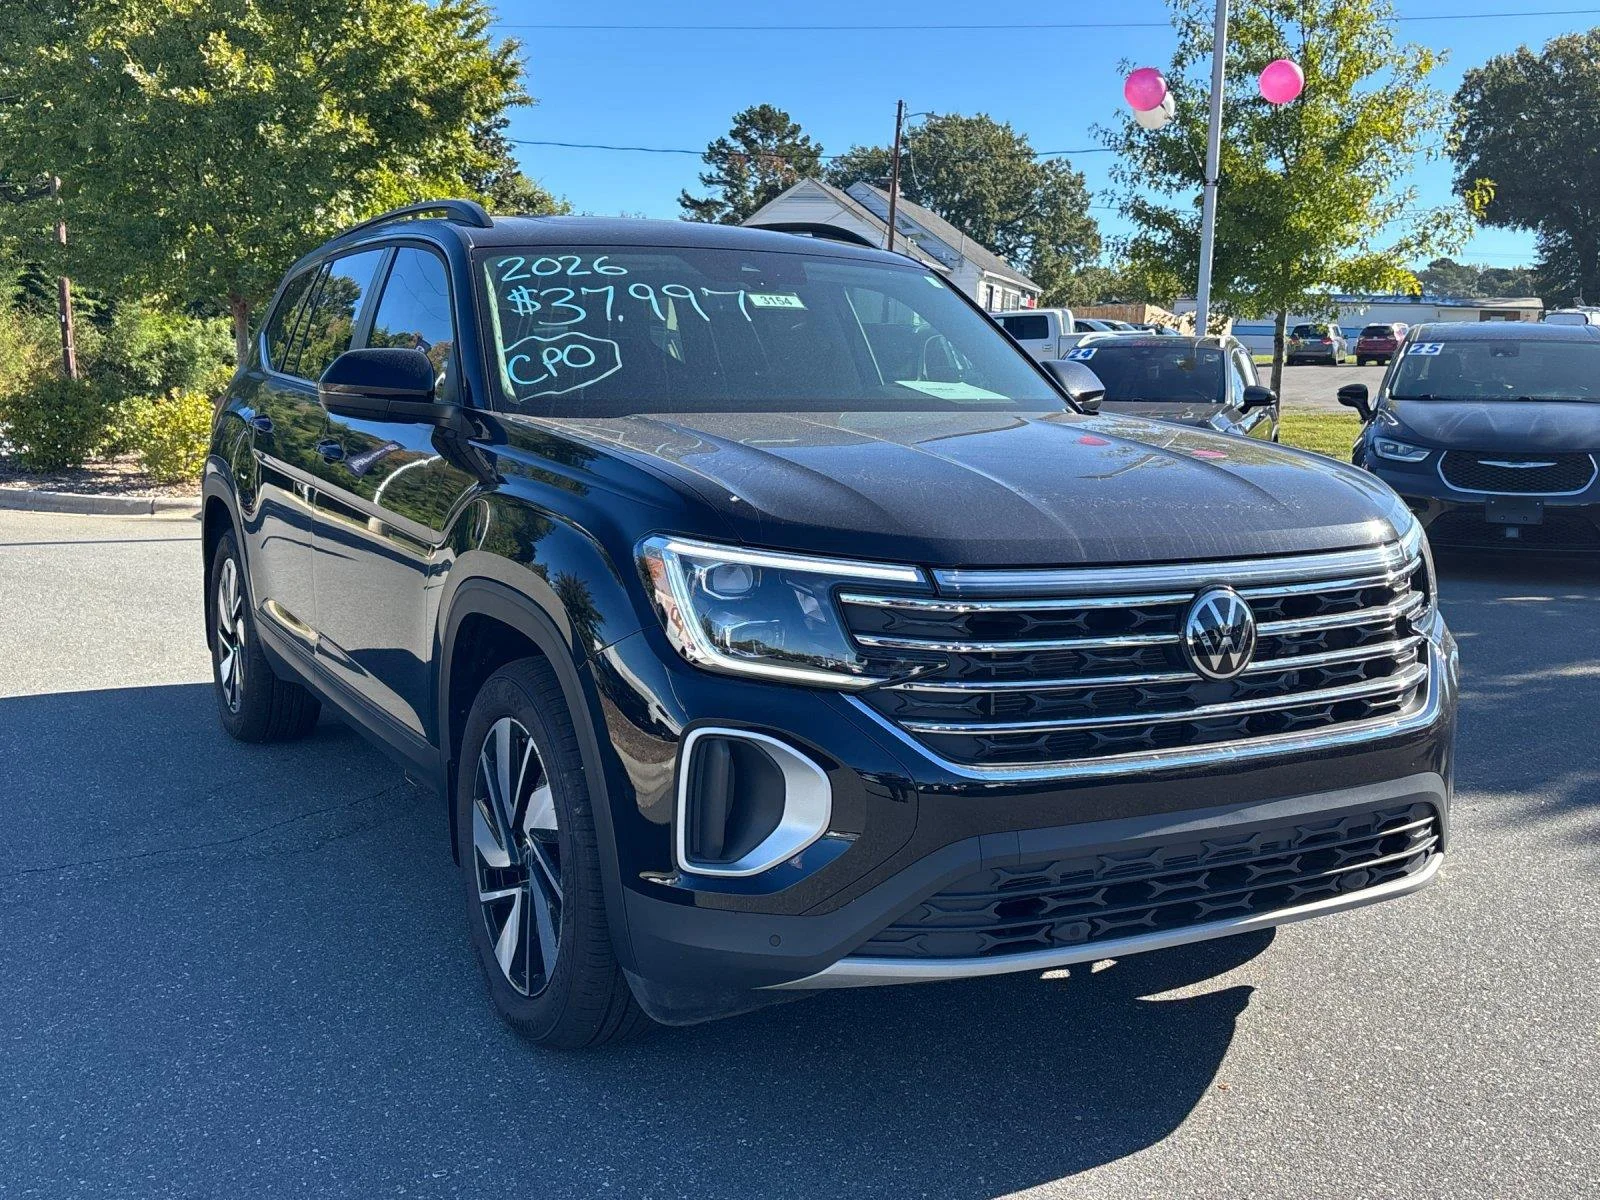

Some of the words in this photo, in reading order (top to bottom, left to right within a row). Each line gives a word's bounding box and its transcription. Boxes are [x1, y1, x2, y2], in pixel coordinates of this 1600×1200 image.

[497, 255, 629, 281] 2026
[760, 295, 793, 306] 3154
[1068, 349, 1093, 359] 24
[1410, 343, 1440, 354] 25
[508, 344, 595, 385] CPO
